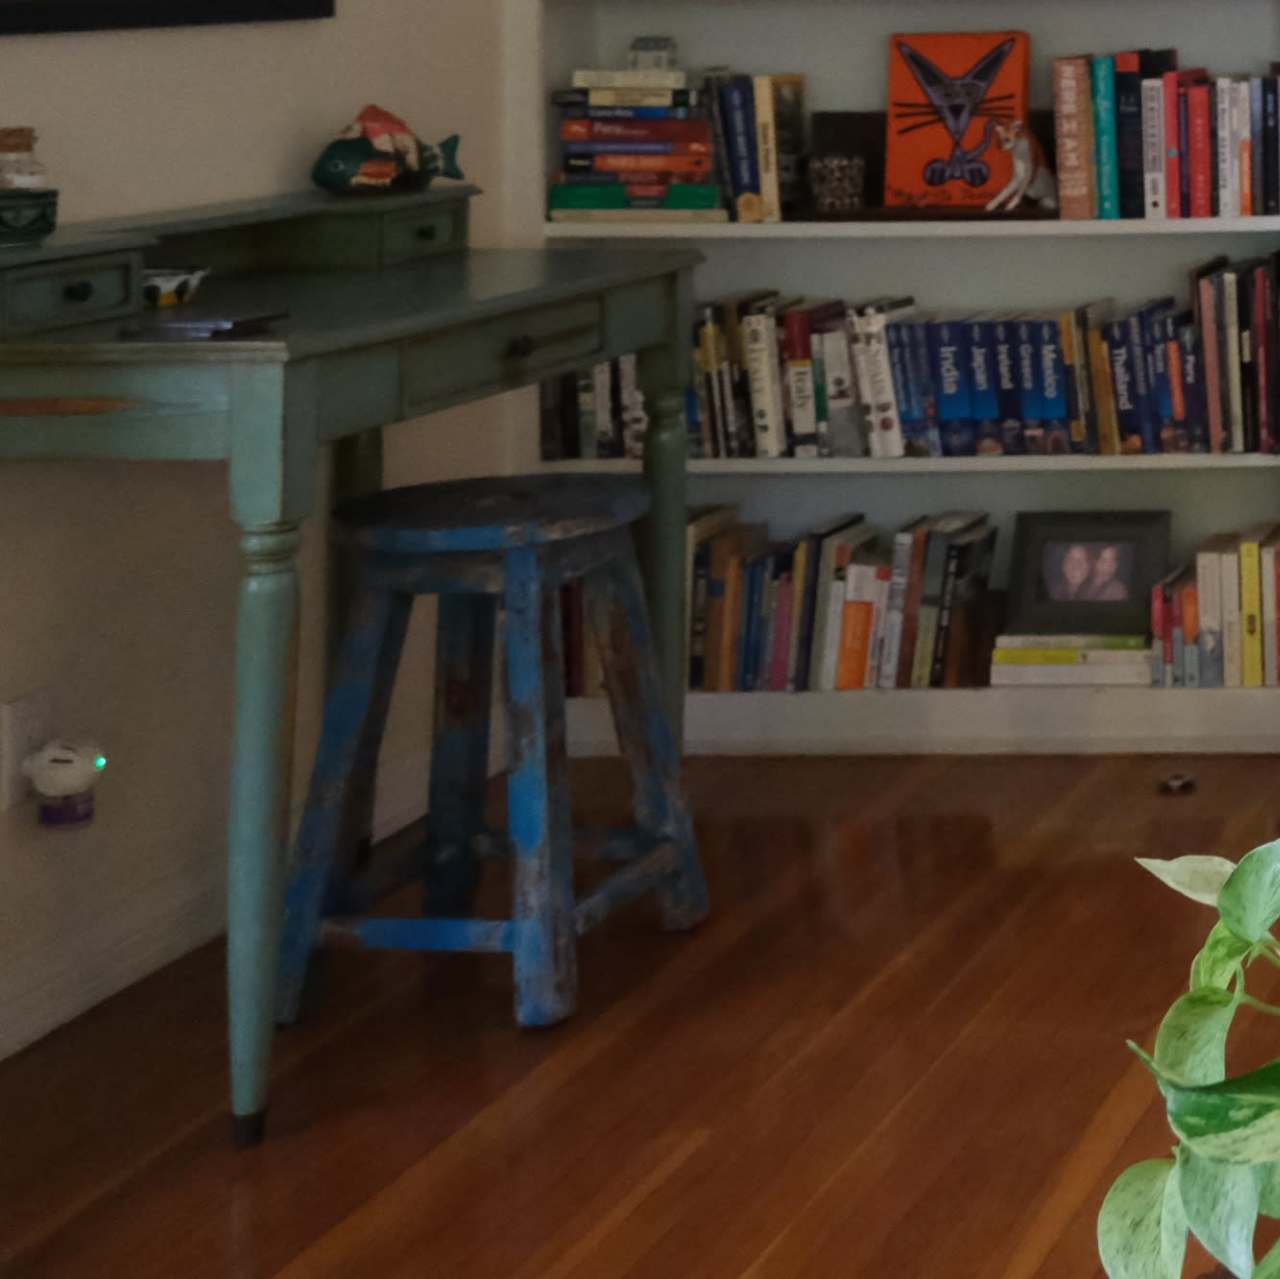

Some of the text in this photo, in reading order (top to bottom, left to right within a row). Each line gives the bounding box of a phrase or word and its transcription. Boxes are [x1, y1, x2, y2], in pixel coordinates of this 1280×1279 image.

[940, 345, 958, 395] India
[970, 345, 989, 391] Japan
[997, 343, 1014, 390] Ireland
[1019, 343, 1035, 391] Greece
[1041, 343, 1059, 400] Mexico
[1111, 347, 1133, 411] Thailand
